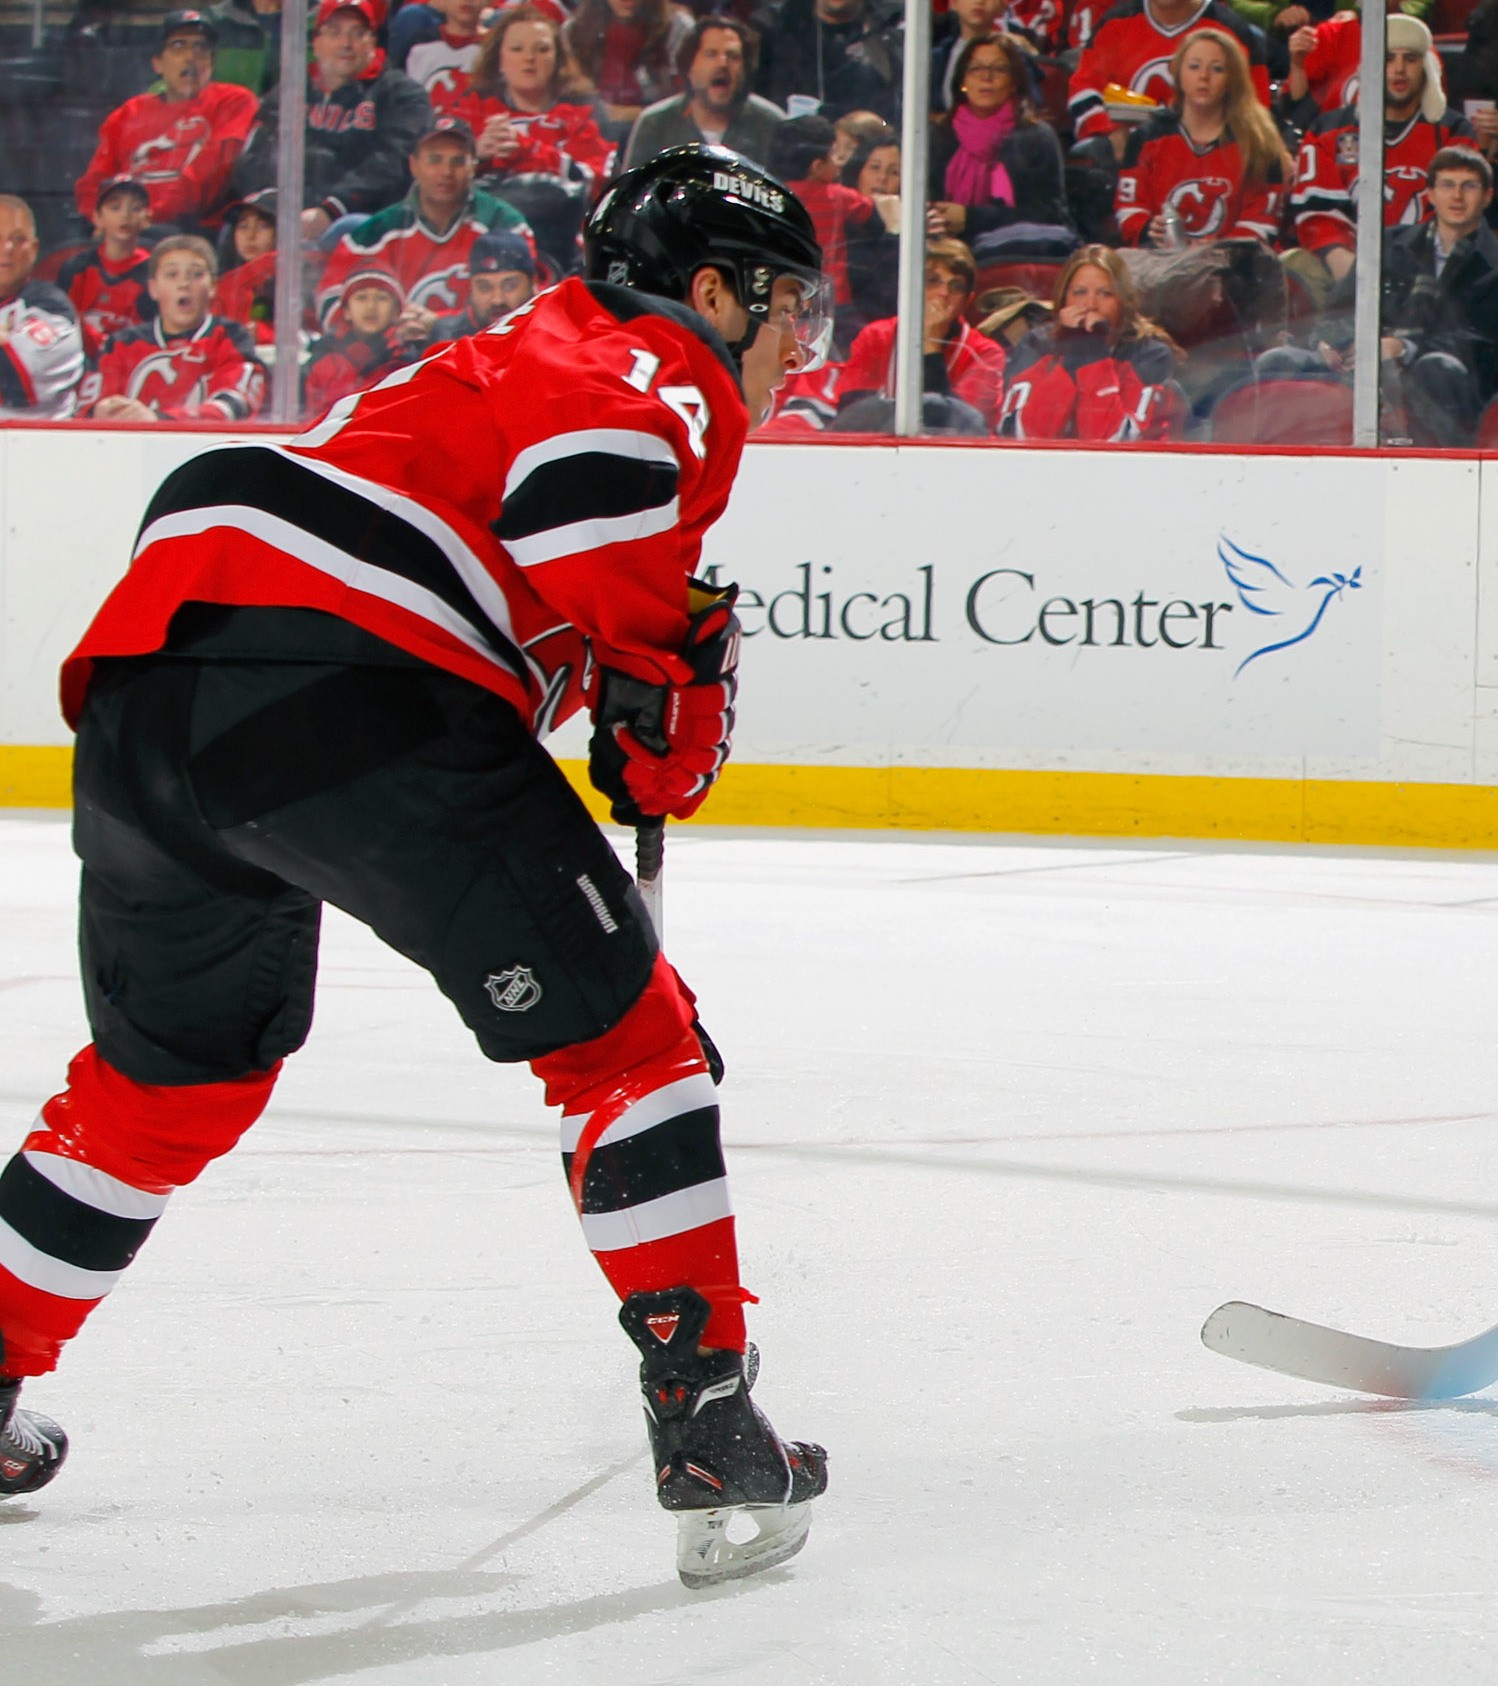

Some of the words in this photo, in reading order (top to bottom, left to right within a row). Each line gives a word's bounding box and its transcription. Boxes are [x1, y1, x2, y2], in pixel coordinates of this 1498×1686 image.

[620, 347, 711, 460] 14
[699, 561, 941, 642] edical
[965, 567, 1234, 650] Center
[576, 874, 618, 933] WARRIOR
